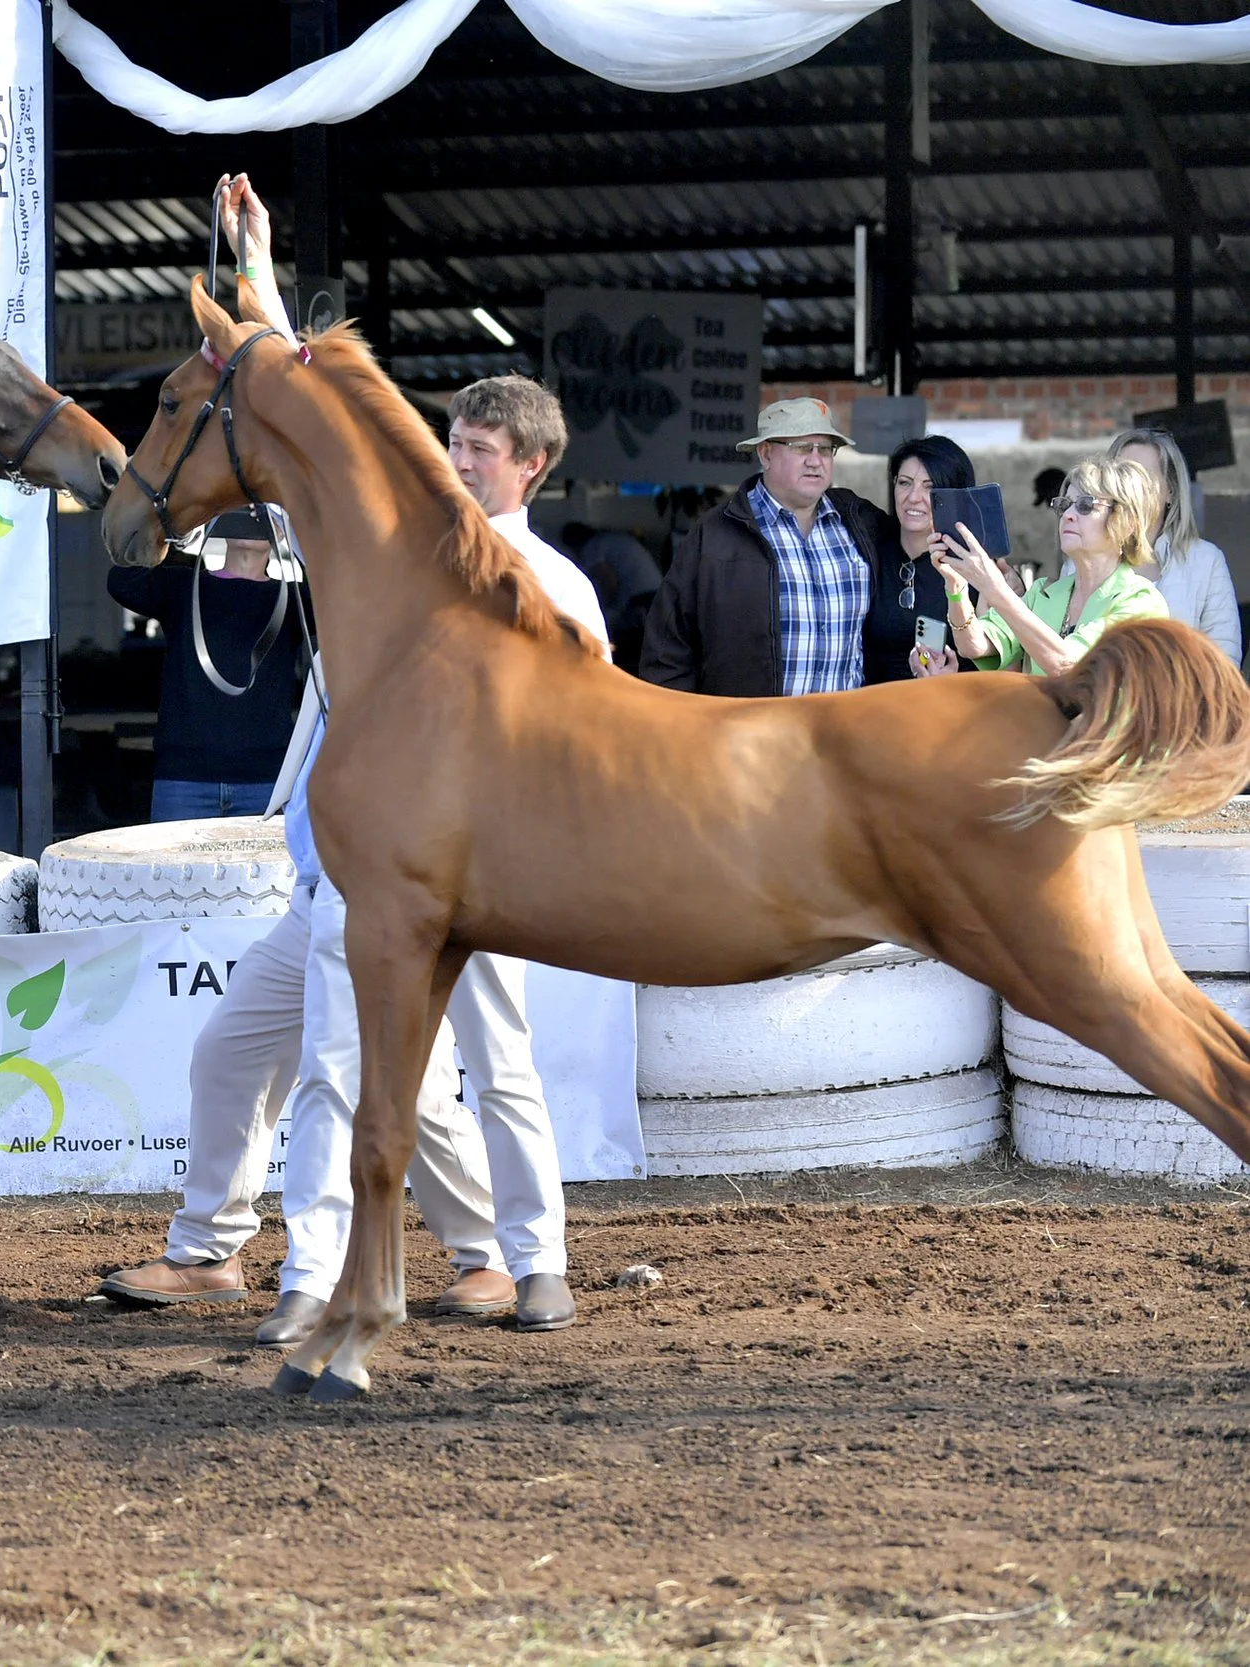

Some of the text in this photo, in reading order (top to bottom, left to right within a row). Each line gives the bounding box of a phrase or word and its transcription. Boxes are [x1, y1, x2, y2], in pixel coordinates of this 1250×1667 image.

[694, 317, 724, 338] Tea
[691, 380, 745, 402] Cakes
[691, 410, 745, 432] Treats
[10, 1136, 46, 1153] Alle
[53, 1137, 122, 1152] Ruvoer
